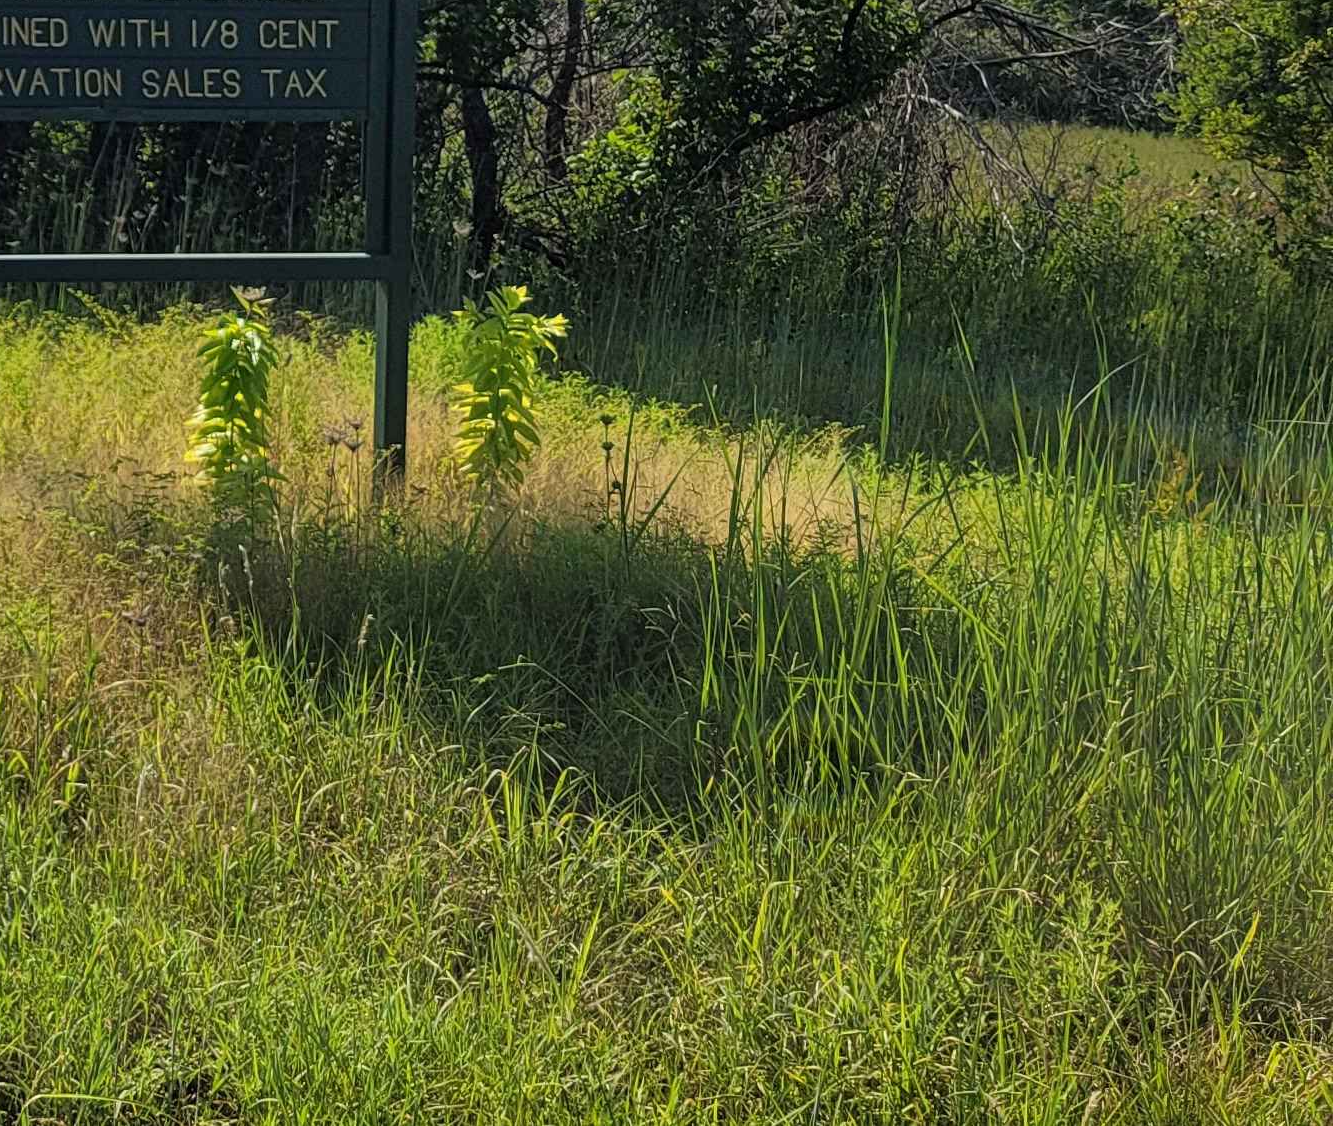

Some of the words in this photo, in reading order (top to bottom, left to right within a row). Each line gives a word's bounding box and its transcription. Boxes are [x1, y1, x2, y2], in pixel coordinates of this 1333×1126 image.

[89, 17, 171, 49] WITH
[258, 19, 340, 50] CENT
[142, 68, 241, 99] SALES
[261, 68, 328, 99] TAX
